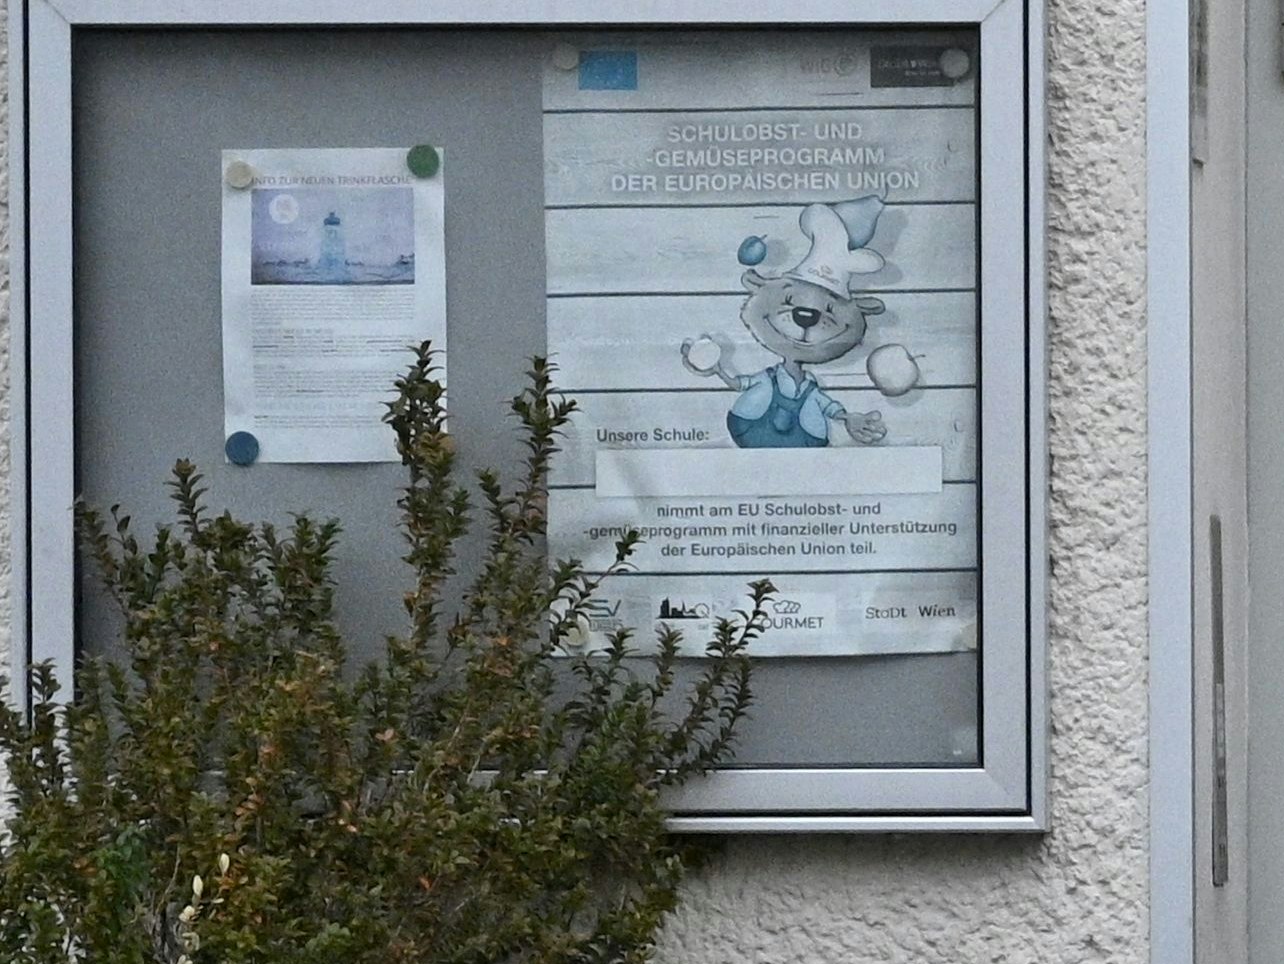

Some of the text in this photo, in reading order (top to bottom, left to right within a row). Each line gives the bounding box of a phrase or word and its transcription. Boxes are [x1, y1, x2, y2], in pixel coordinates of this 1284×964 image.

[667, 122, 863, 143] SCHULOBST- UND
[646, 146, 885, 168] -GEMÜSEPROGRAMM
[611, 169, 920, 192] DER EUROPÄISCHEN UNION
[596, 427, 710, 442] Unsere Schule:
[656, 502, 882, 518] nimmt am EU Schulobst- und
[732, 523, 757, 537] mit
[761, 521, 845, 537] finanzieller
[849, 520, 958, 537] Unterstützung
[660, 540, 878, 559] der Europäischen Union teil.
[917, 603, 957, 618] Wien
